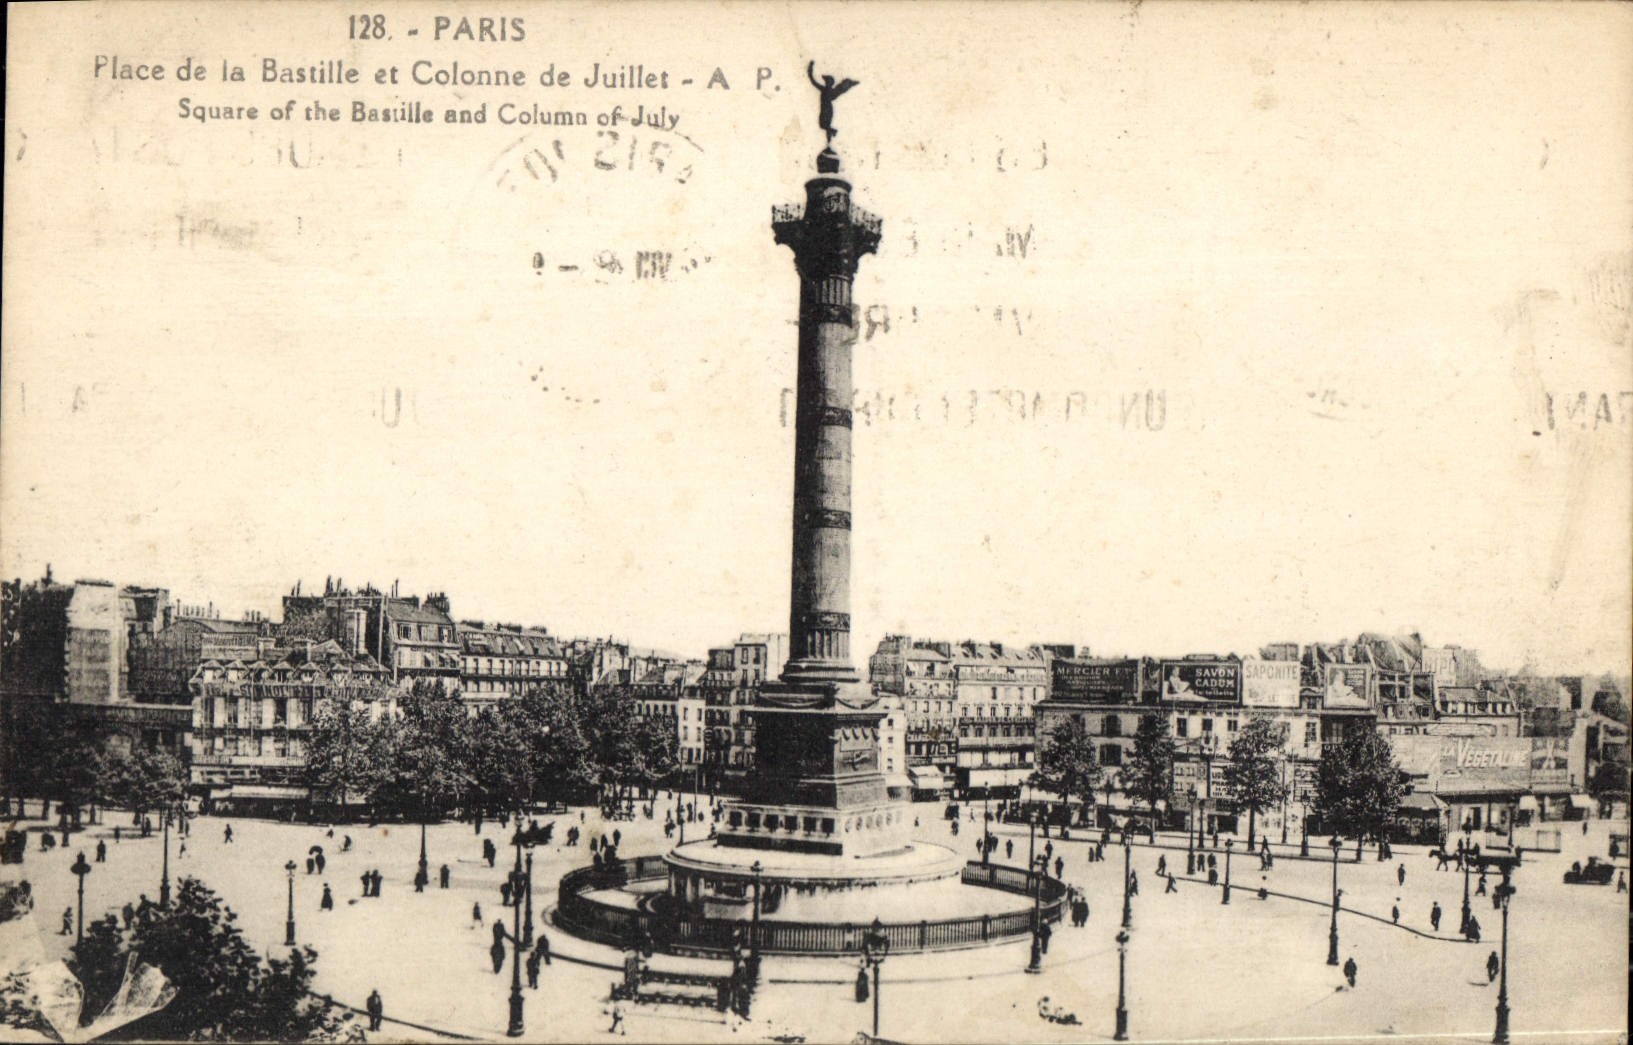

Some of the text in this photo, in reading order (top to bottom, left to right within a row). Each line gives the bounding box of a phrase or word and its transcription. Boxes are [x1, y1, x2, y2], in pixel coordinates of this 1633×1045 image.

[1056, 666, 1110, 675] MERCIER
[1195, 668, 1235, 678] SAVON
[1245, 664, 1298, 680] SAPONITE
[1195, 679, 1235, 688] CADUM
